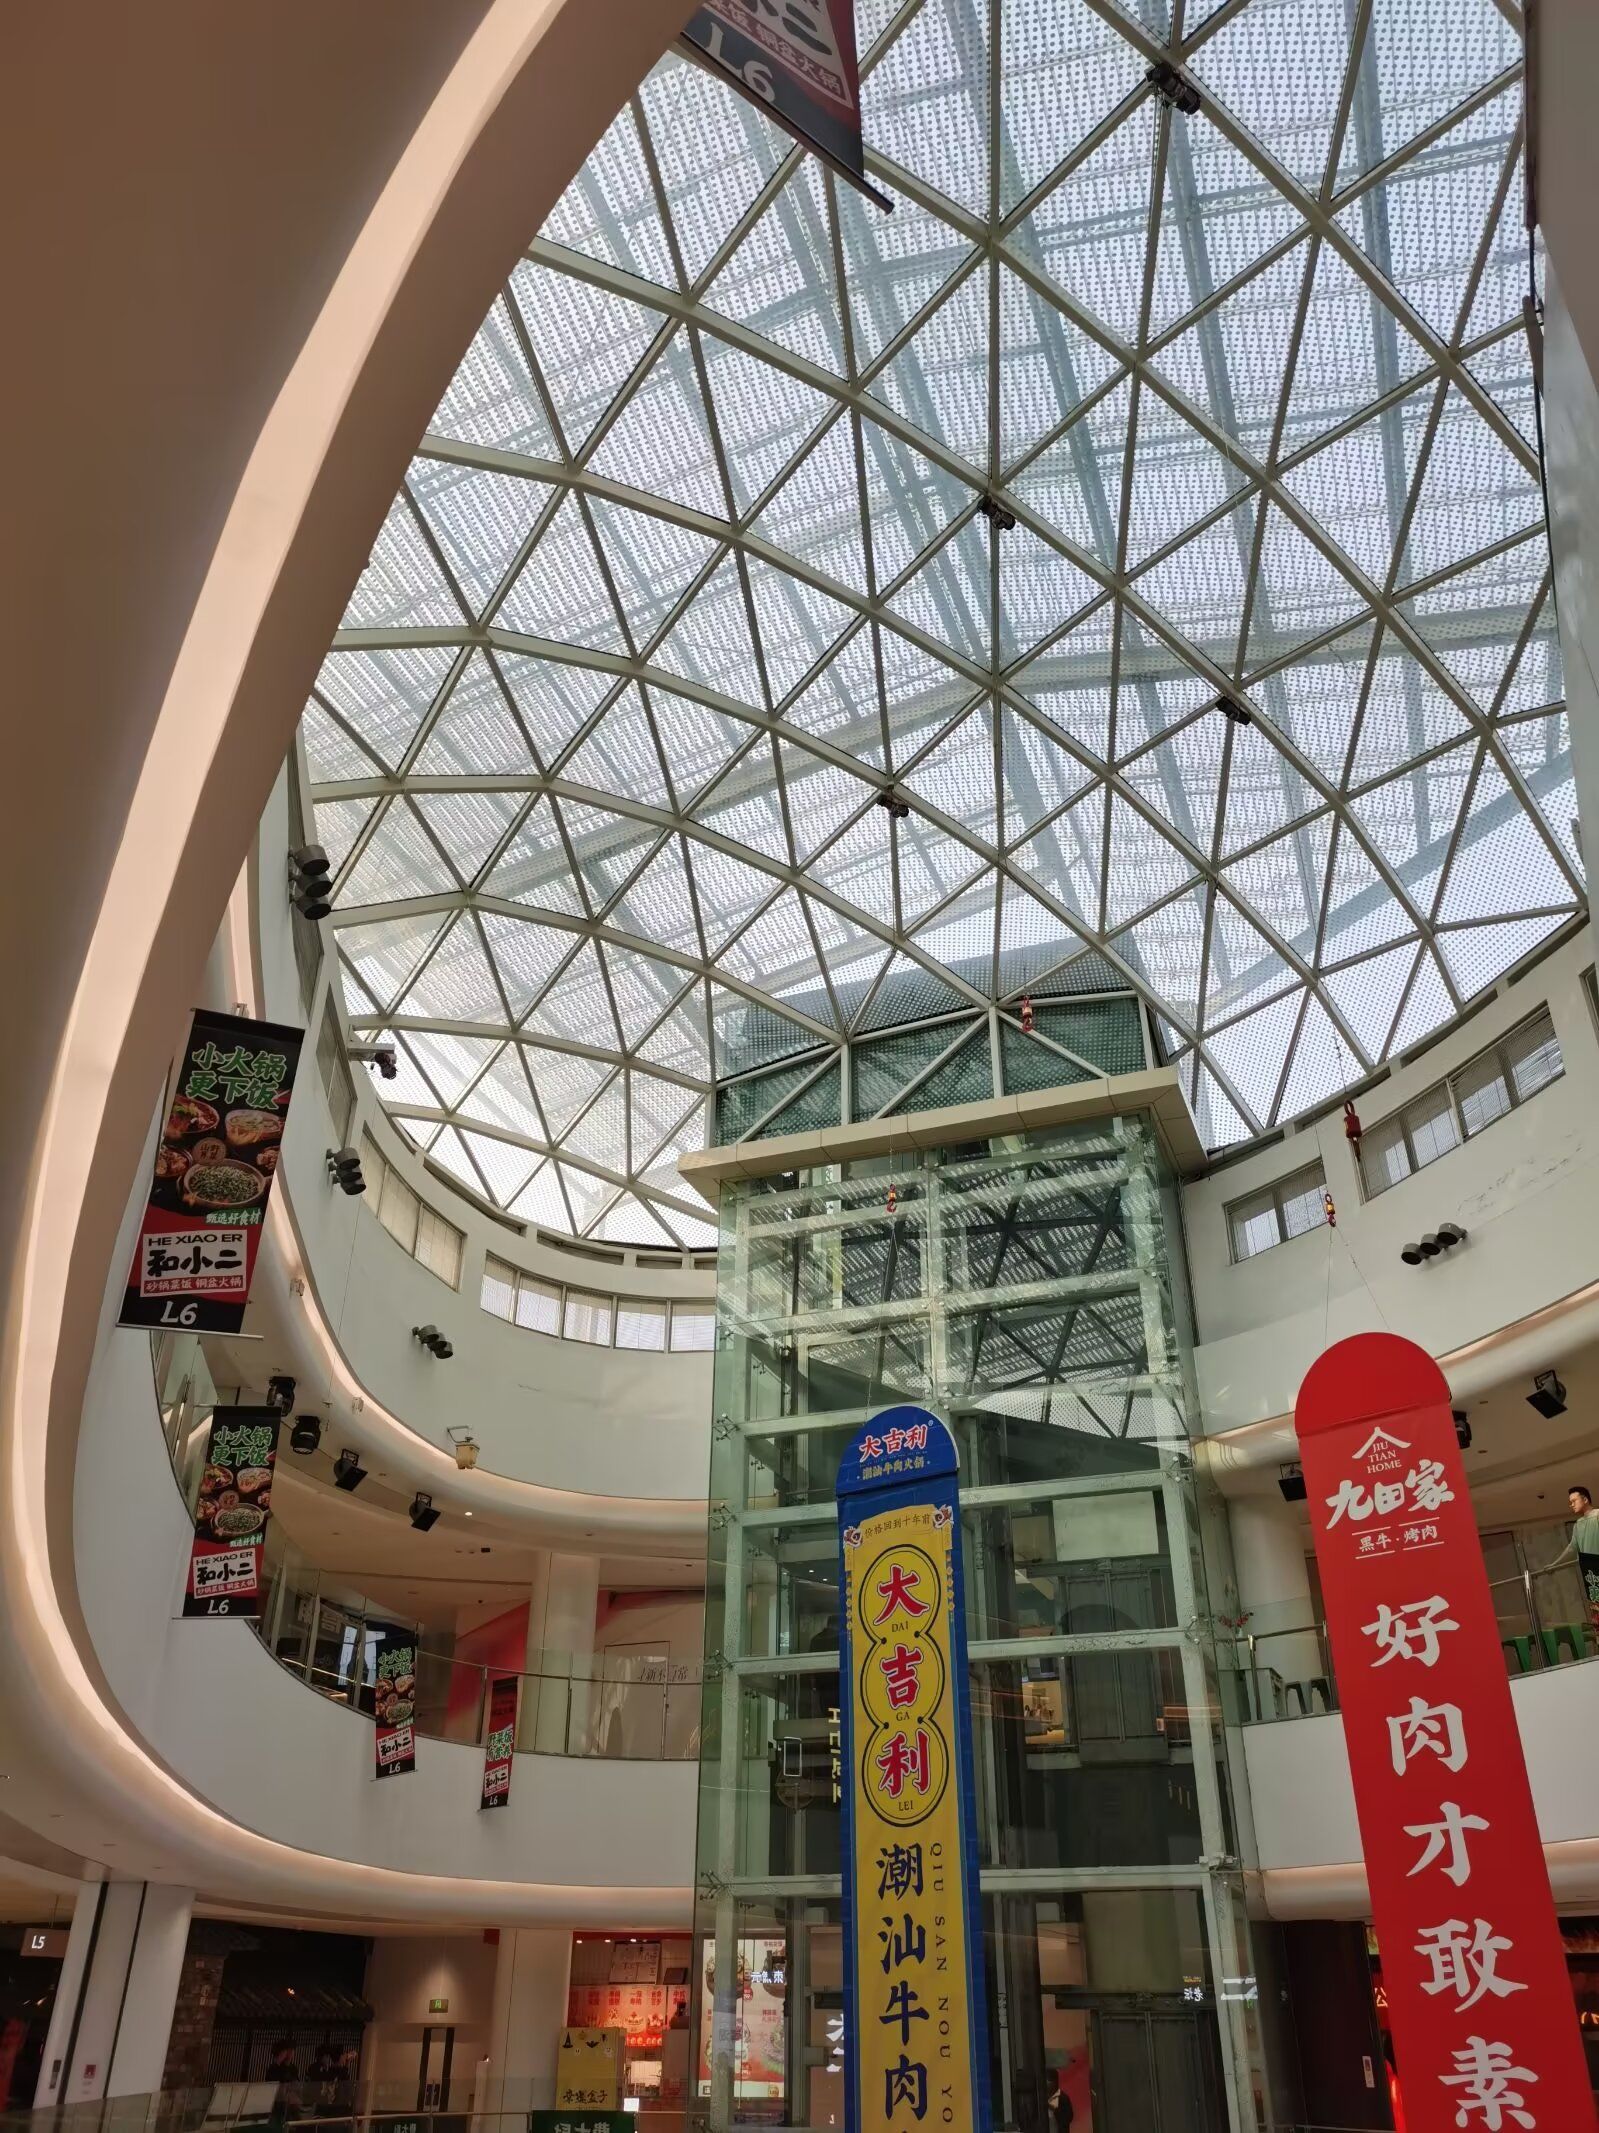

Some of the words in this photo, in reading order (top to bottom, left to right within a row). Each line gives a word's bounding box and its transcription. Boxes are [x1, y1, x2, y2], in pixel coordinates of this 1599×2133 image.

[706, 22, 776, 101] L6
[191, 1041, 287, 1082] 小火锅
[185, 1070, 280, 1110] 更下饭
[205, 1208, 262, 1226] 甄选好食材
[148, 1237, 172, 1246] HE
[176, 1234, 217, 1243] XIAO
[221, 1233, 243, 1243] ER
[147, 1246, 242, 1277] 和小二
[145, 1278, 192, 1292] 砂锅菜饭
[160, 1301, 199, 1325] L6
[213, 1425, 273, 1447] 小火锅
[859, 1424, 928, 1463] 大吉利
[1372, 1441, 1389, 1453] JIU
[211, 1445, 269, 1467] 更下饭
[1367, 1449, 1397, 1463] TIAN
[1367, 1459, 1402, 1474] HOME
[1325, 1459, 1455, 1530] 九田家
[864, 1513, 931, 1538] 价格回到十年前
[196, 1558, 211, 1566] HE
[213, 1553, 238, 1563] XIAO
[240, 1551, 253, 1559] ER
[197, 1562, 254, 1585] 和小二
[207, 1599, 230, 1614] L6
[891, 1621, 909, 1633] DAI
[873, 1563, 930, 1798] 大吉利
[895, 1710, 910, 1721] GA
[380, 1736, 411, 1757] 和小二
[389, 1762, 401, 1774] L6
[489, 1795, 498, 1806] L6
[898, 1800, 913, 1812] LEI
[930, 1842, 944, 1892] QIU
[1361, 1595, 1539, 2132] 好肉才敢素
[31, 1935, 46, 1949] L5
[934, 1915, 947, 1972] SAN
[875, 1842, 930, 2121] 潮汕牛肉
[938, 1997, 951, 2058] NOU
